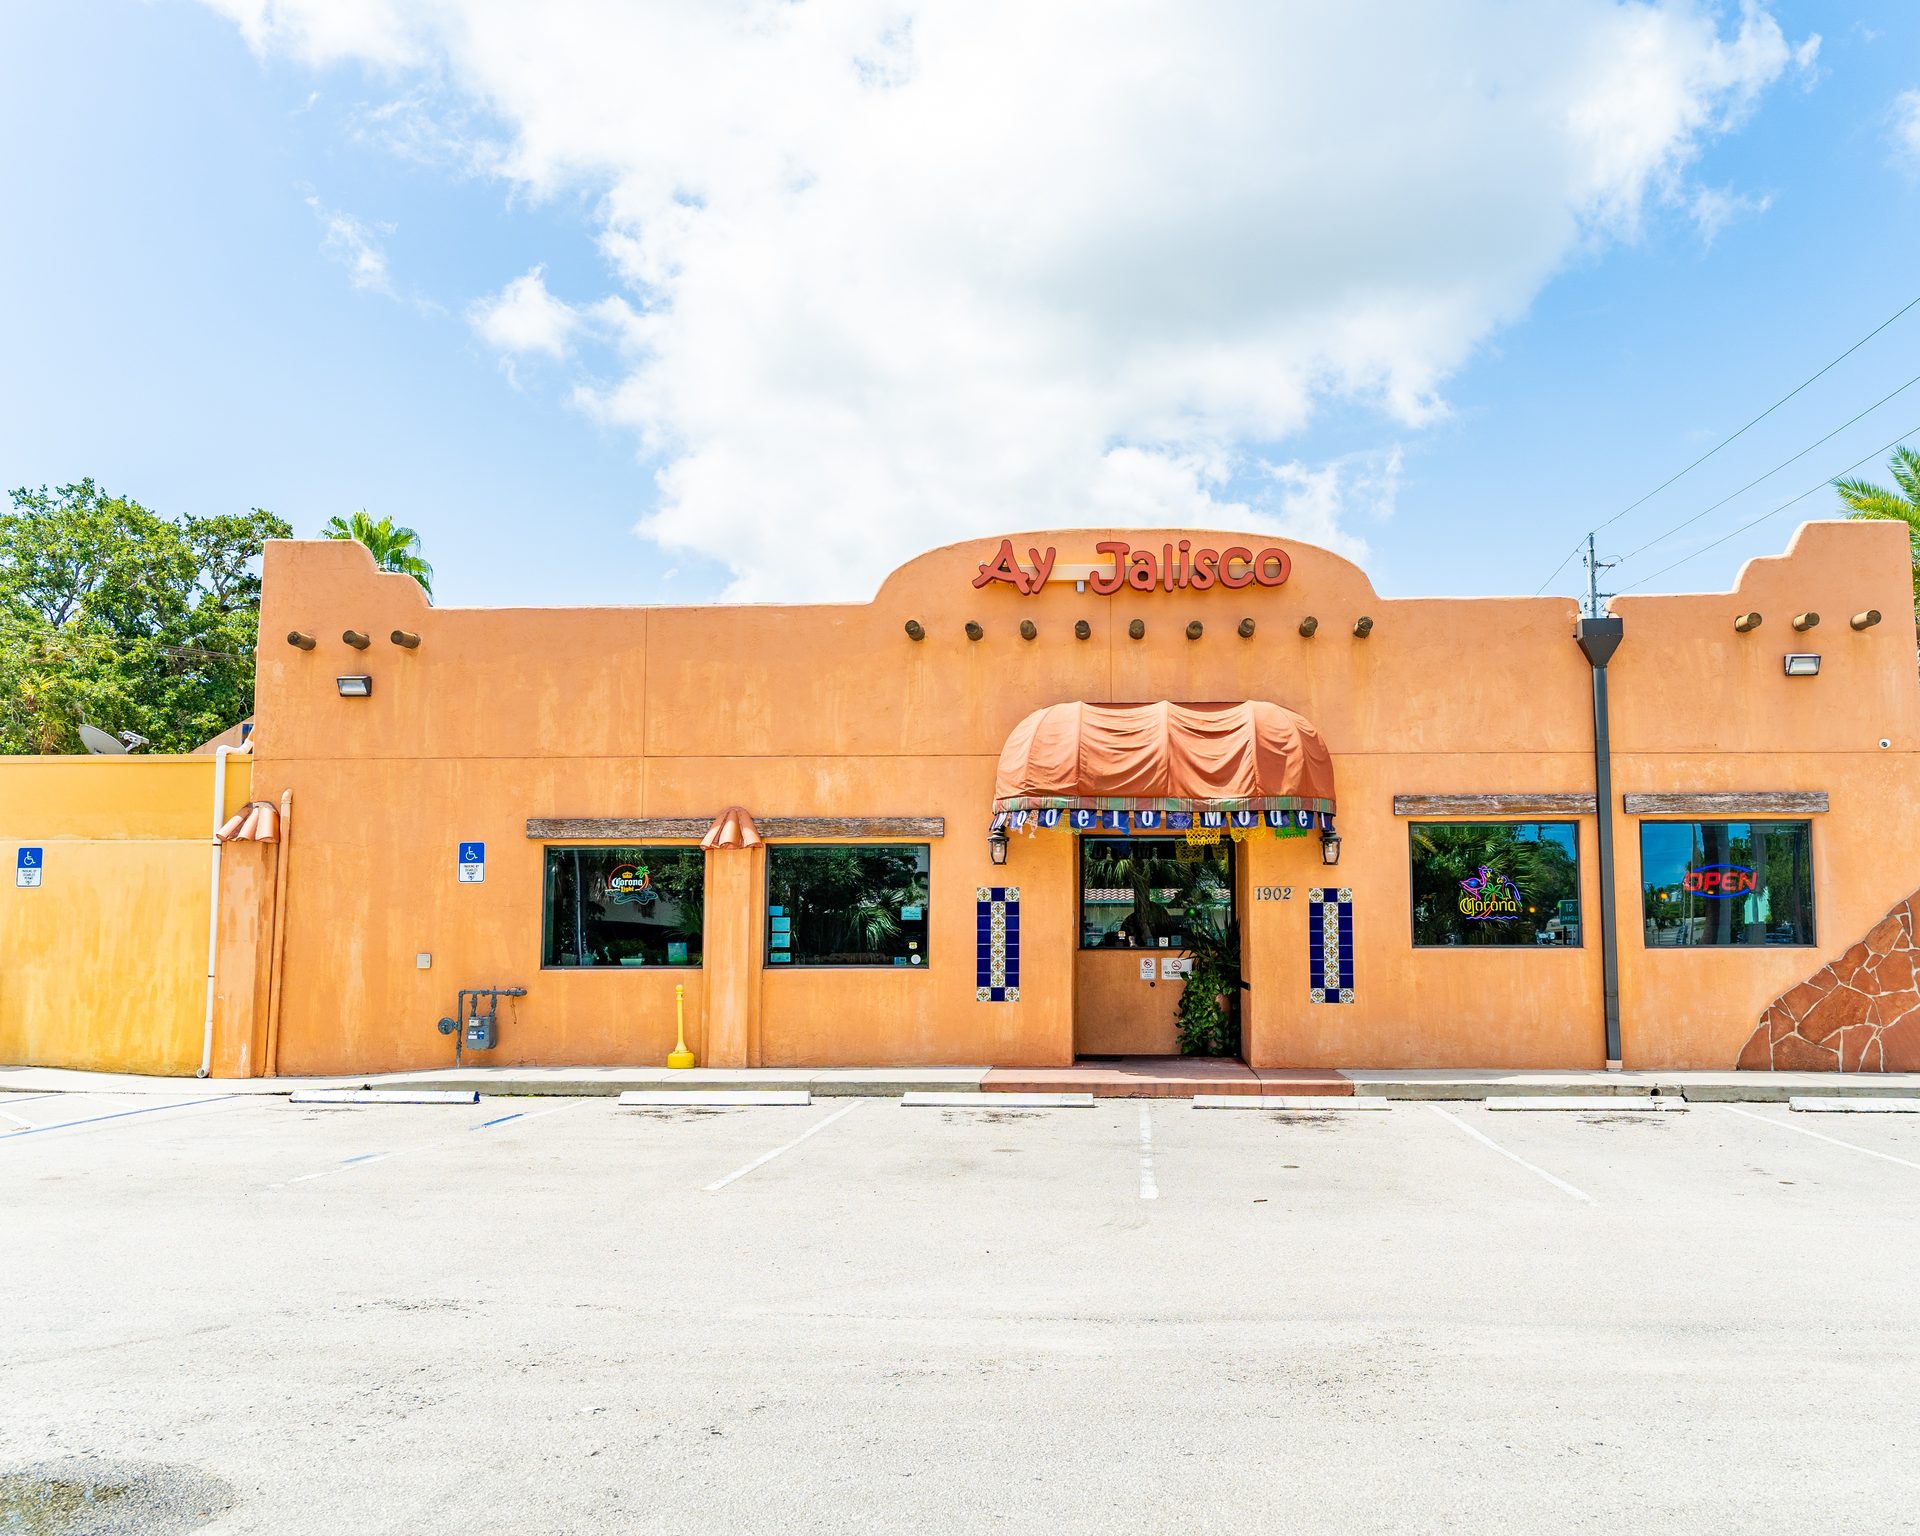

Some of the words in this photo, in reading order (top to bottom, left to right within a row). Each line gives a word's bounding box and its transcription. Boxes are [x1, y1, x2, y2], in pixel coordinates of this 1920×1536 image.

[972, 539, 1056, 595] Ay
[1089, 540, 1291, 595] Jalisco
[611, 877, 643, 888] Corona
[1683, 872, 1757, 891] OPEN
[1256, 887, 1291, 900] 1902
[1460, 897, 1517, 916] Corona
